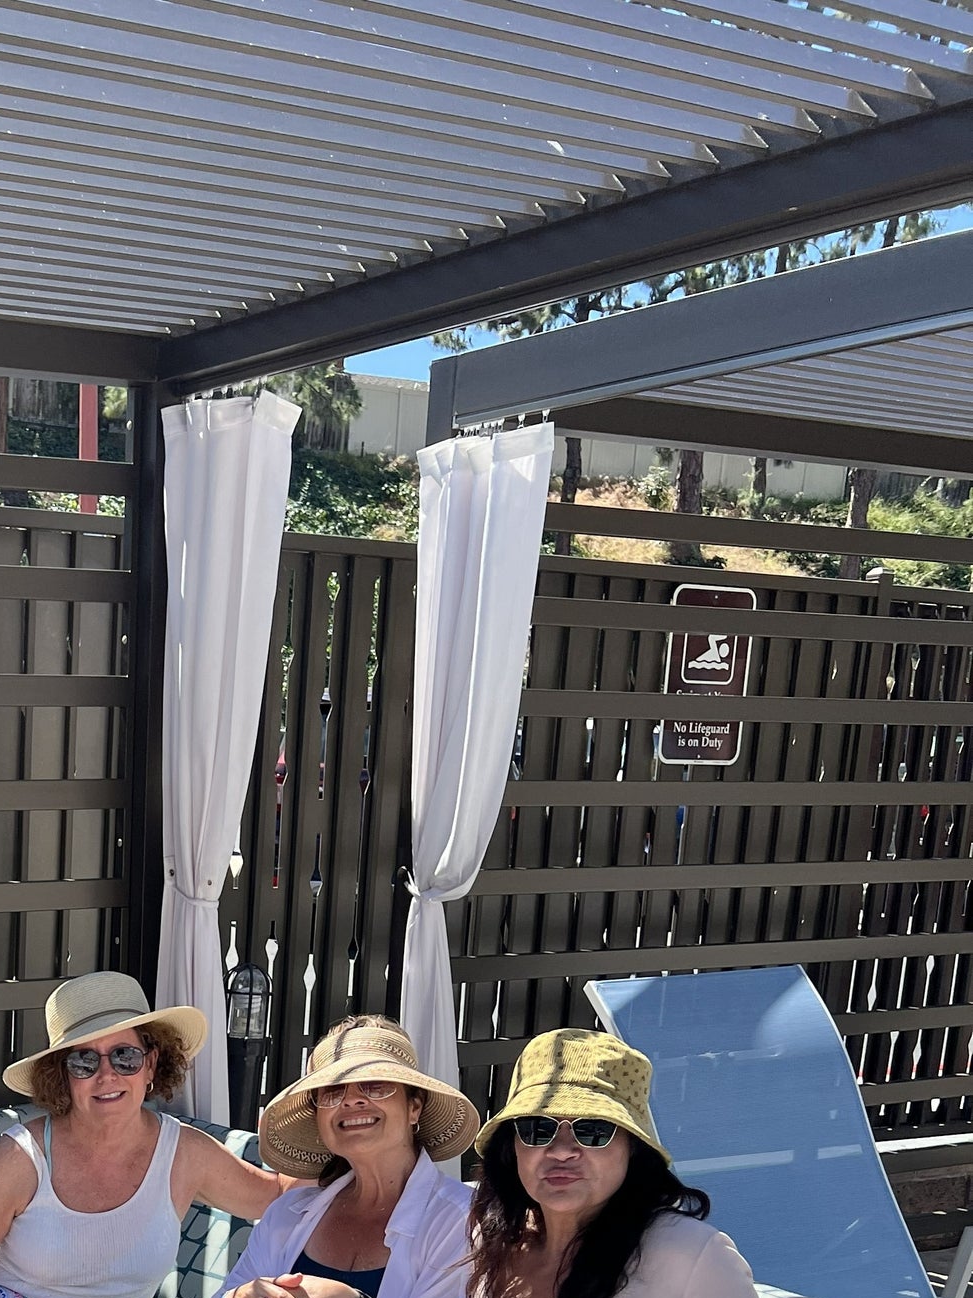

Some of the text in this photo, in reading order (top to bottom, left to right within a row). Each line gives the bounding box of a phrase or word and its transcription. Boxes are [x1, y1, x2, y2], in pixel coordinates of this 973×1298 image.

[673, 721, 730, 737] No Lifeguard
[677, 735, 724, 751] is on Duty
